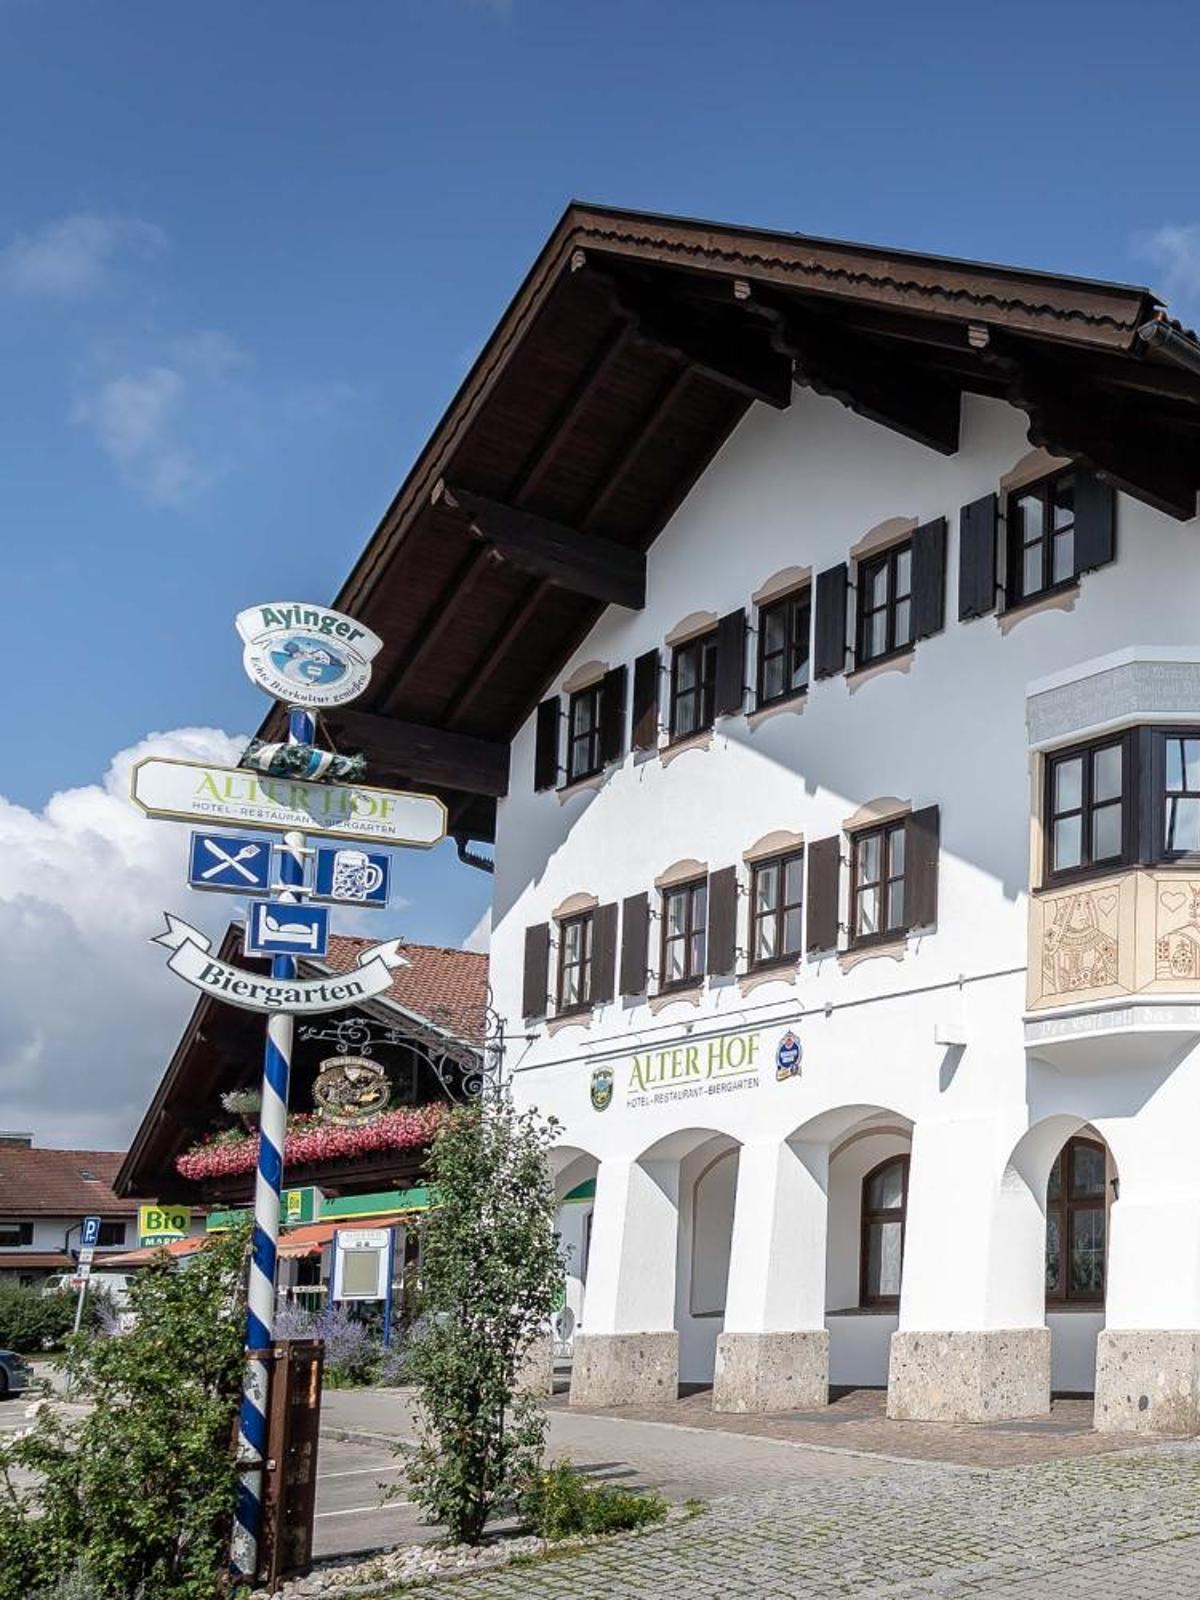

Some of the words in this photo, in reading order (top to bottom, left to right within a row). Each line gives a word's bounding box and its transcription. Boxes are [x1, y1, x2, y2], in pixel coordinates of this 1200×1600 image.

[261, 604, 365, 641] Ayinger
[270, 680, 329, 703] Bierkultur
[192, 771, 311, 812] ALTER
[320, 785, 398, 818] HOF
[192, 801, 232, 816] HOTEL
[199, 962, 365, 1009] Biergarten
[629, 1041, 700, 1092] ALTER
[706, 1032, 761, 1079] HOF
[147, 1210, 186, 1230] Bio
